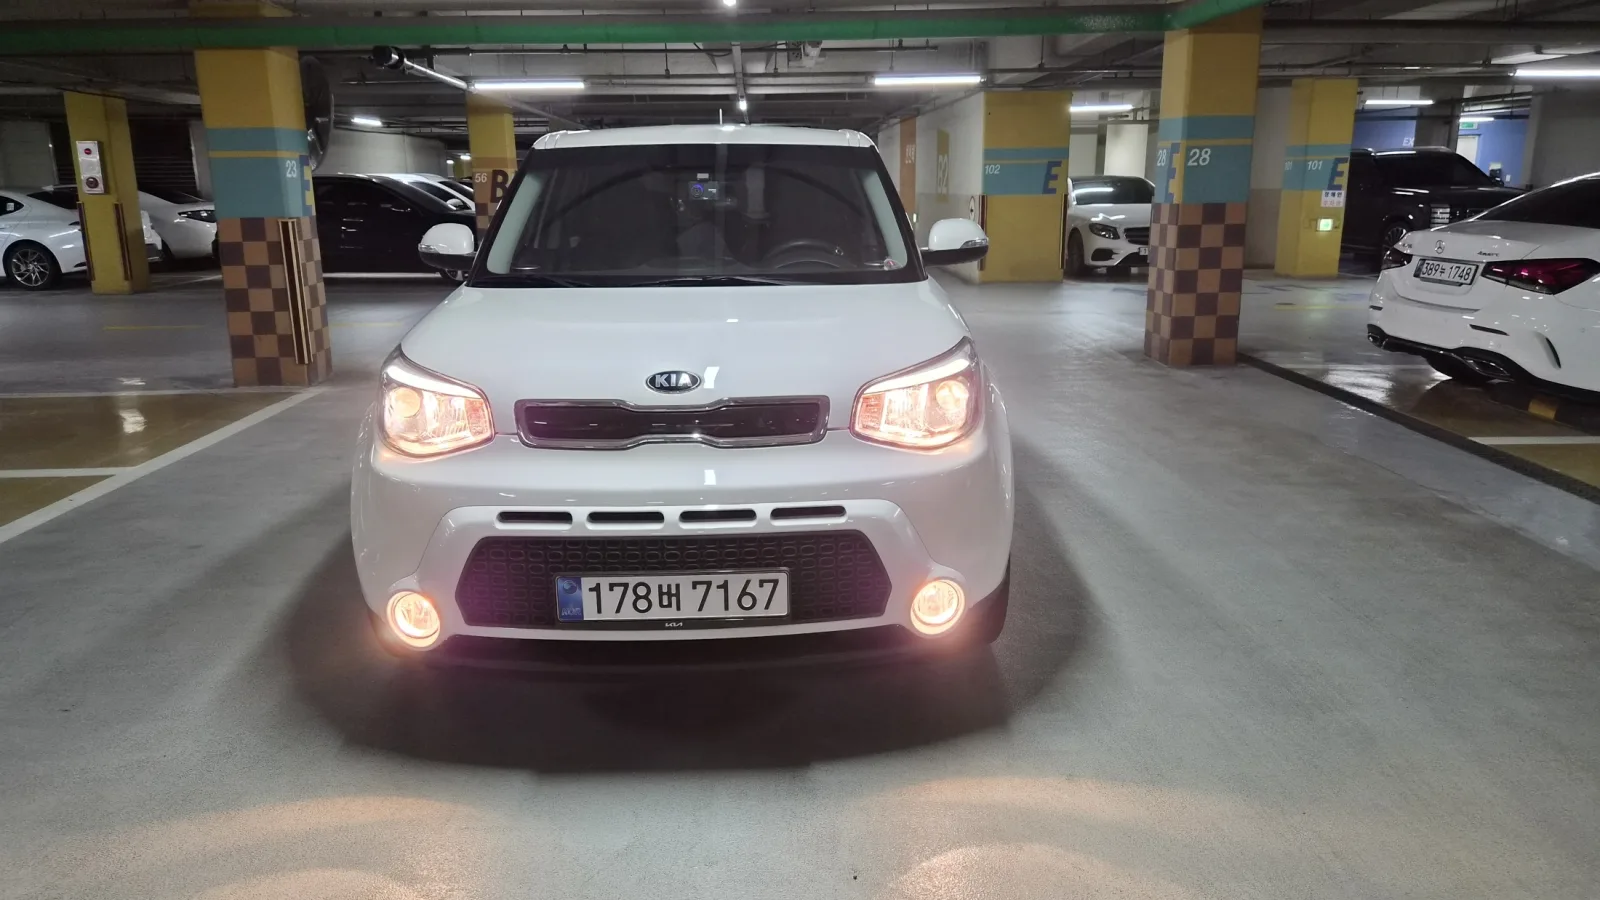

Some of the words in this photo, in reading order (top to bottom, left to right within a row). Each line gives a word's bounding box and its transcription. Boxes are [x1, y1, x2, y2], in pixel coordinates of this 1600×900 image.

[1157, 148, 1167, 166] 28
[1187, 148, 1211, 166] 28
[1307, 160, 1323, 171] 101
[286, 160, 297, 178] 23
[475, 173, 487, 183] 56
[984, 164, 1001, 175] 102
[1042, 160, 1063, 195] E
[1327, 157, 1349, 190] E
[490, 169, 509, 203] B
[1447, 264, 1472, 281] 1748
[655, 373, 693, 388] KIA
[588, 581, 681, 615] 178버
[691, 578, 779, 612] 7167
